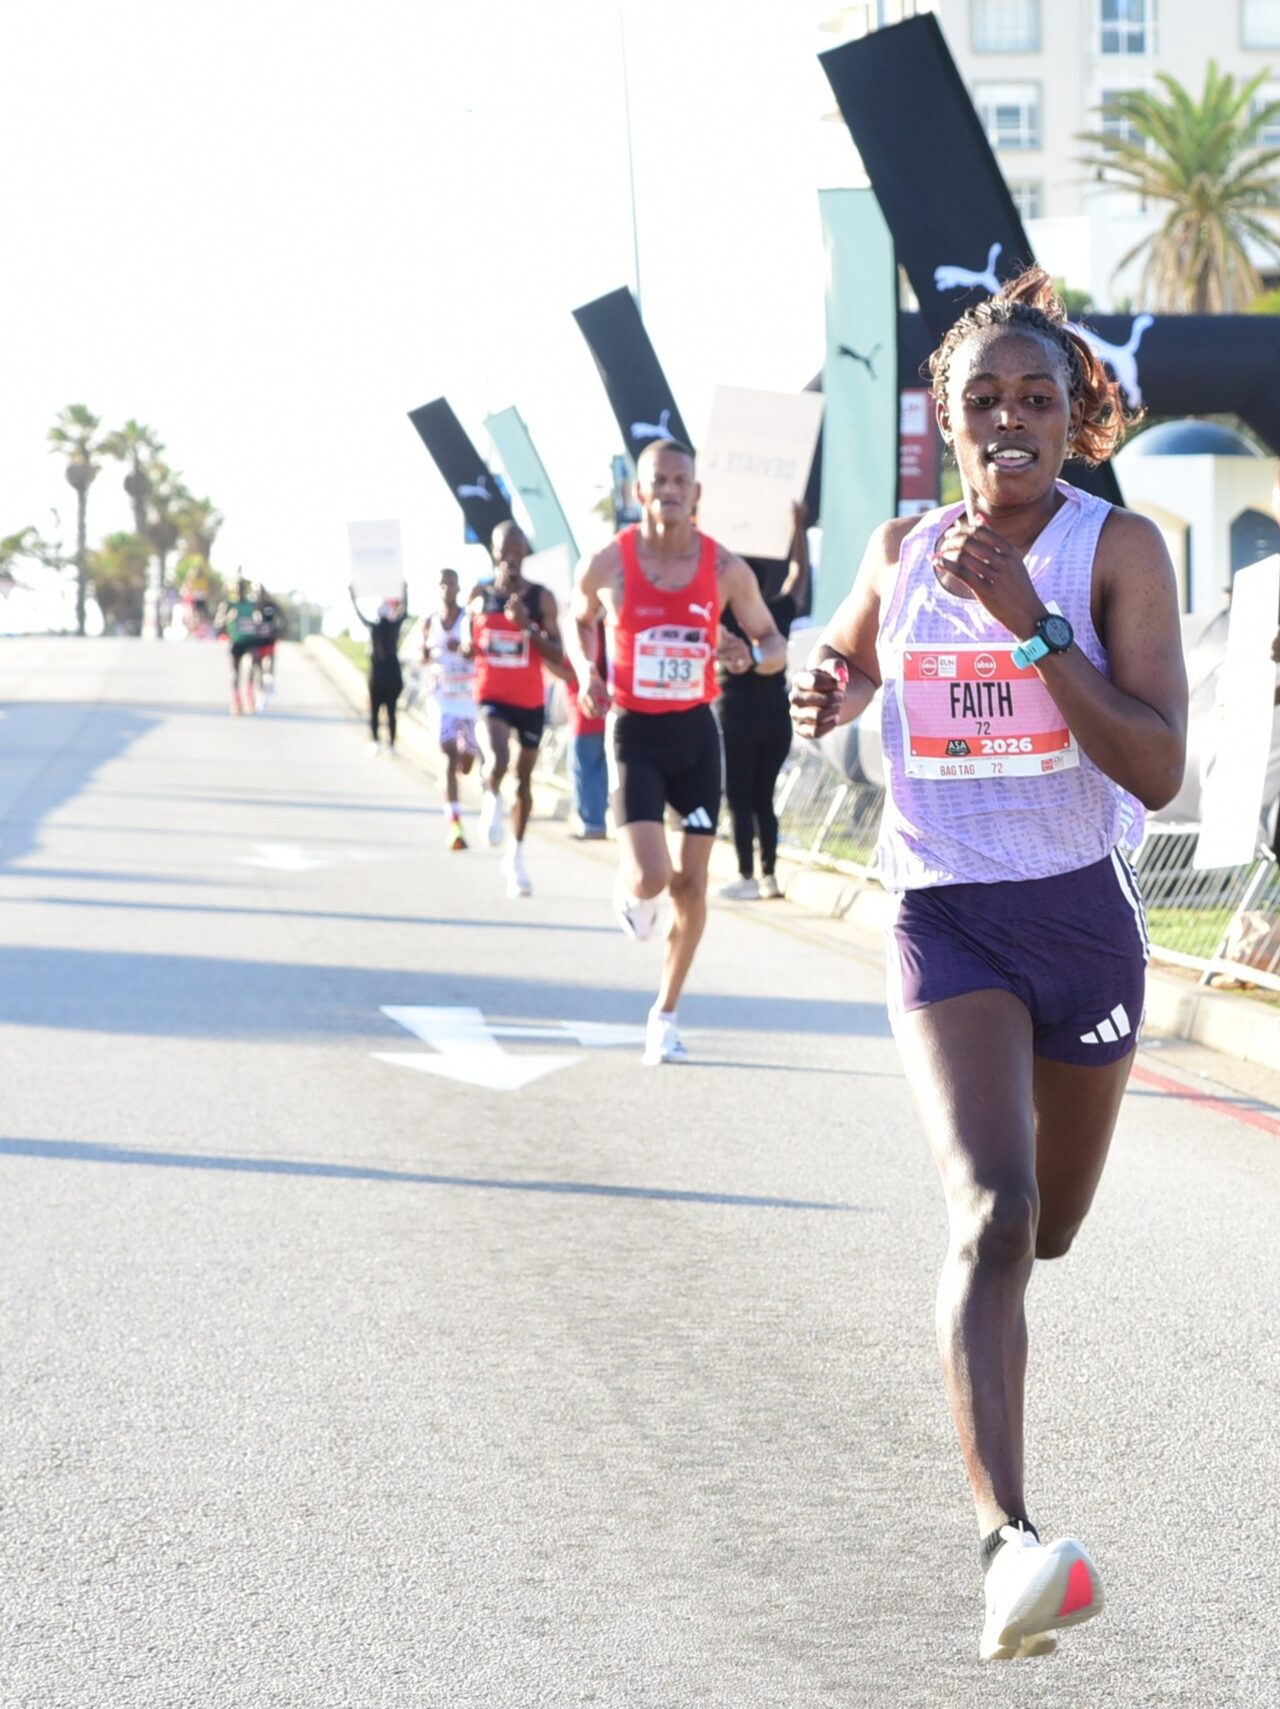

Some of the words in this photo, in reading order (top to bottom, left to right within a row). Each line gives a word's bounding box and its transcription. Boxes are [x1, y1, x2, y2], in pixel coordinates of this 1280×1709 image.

[657, 659, 692, 681] 133
[976, 660, 993, 669] absa
[950, 682, 1013, 718] FAITH
[975, 721, 991, 735] 72
[949, 741, 967, 752] ASA
[981, 738, 1033, 754] 2026
[940, 765, 957, 776] BAG
[958, 764, 975, 776] TAG
[991, 763, 1004, 774] 72
